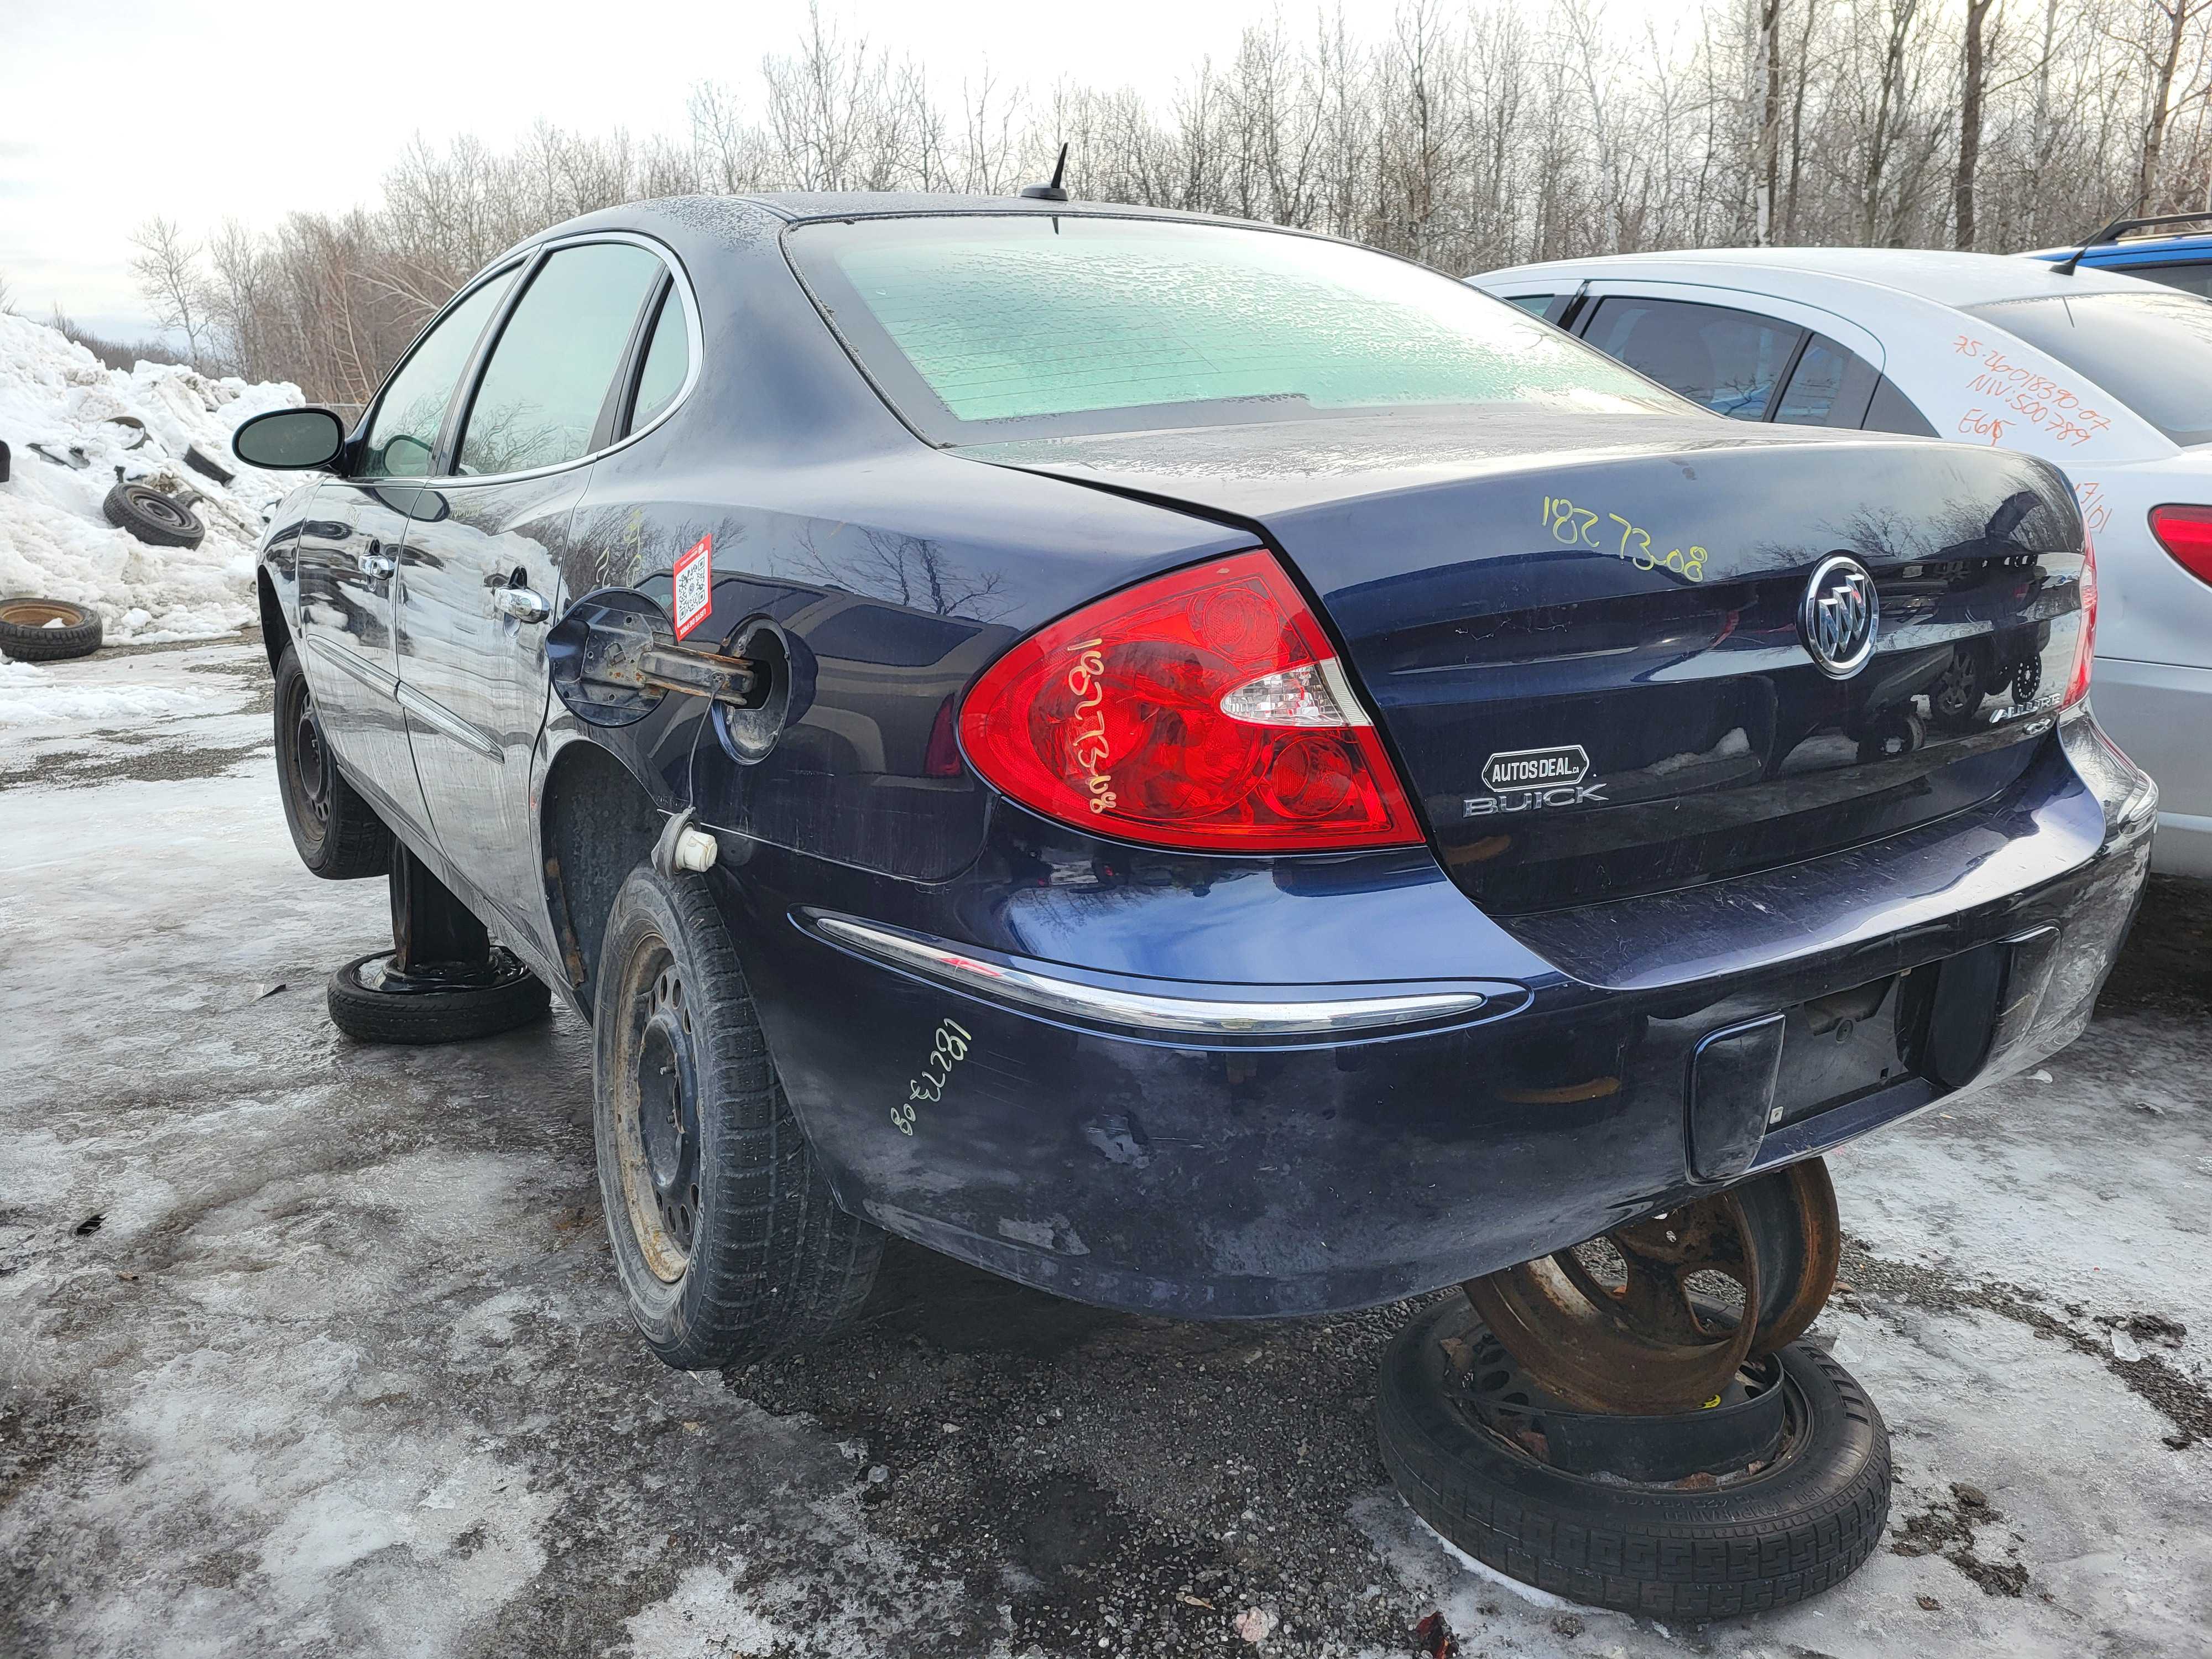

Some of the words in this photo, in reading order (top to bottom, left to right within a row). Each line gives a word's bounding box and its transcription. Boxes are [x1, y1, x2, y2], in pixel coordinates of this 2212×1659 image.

[2075, 482, 2112, 534] 7/01
[688, 618, 695, 627] DE
[694, 608, 707, 622] LISTE
[679, 623, 690, 636] PRIX
[1989, 693, 2061, 723] ALLURE
[2022, 718, 2052, 735] CX
[1463, 782, 1610, 818] BUICK
[1796, 1344, 1870, 1427] RELLI
[1794, 1485, 1827, 1505] USO
